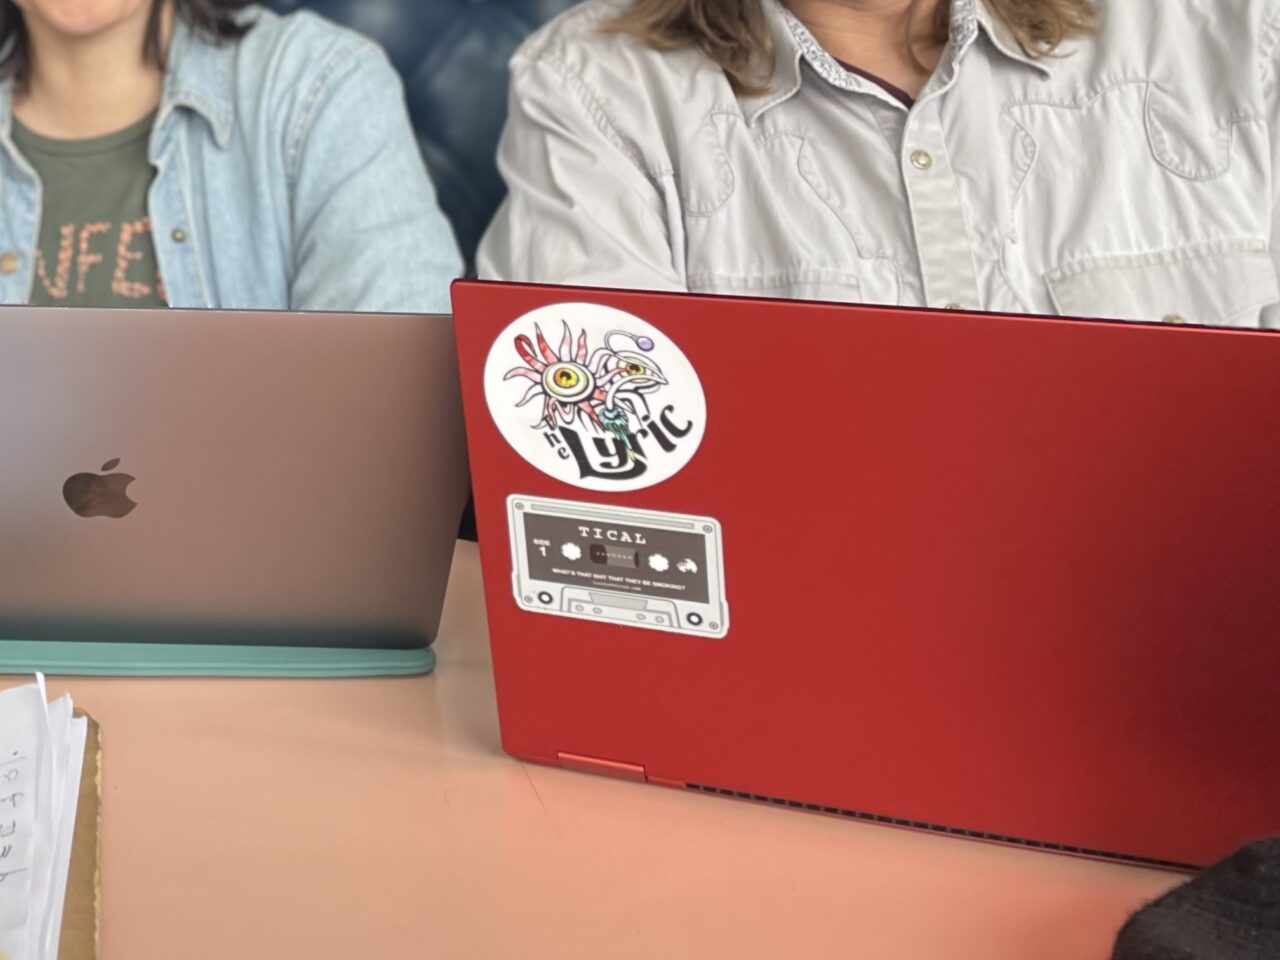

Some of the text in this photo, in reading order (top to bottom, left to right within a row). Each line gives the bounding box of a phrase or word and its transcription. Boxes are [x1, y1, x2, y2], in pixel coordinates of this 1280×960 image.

[558, 403, 693, 481] Lyric
[578, 526, 647, 545] TICAL
[539, 546, 547, 557] 1
